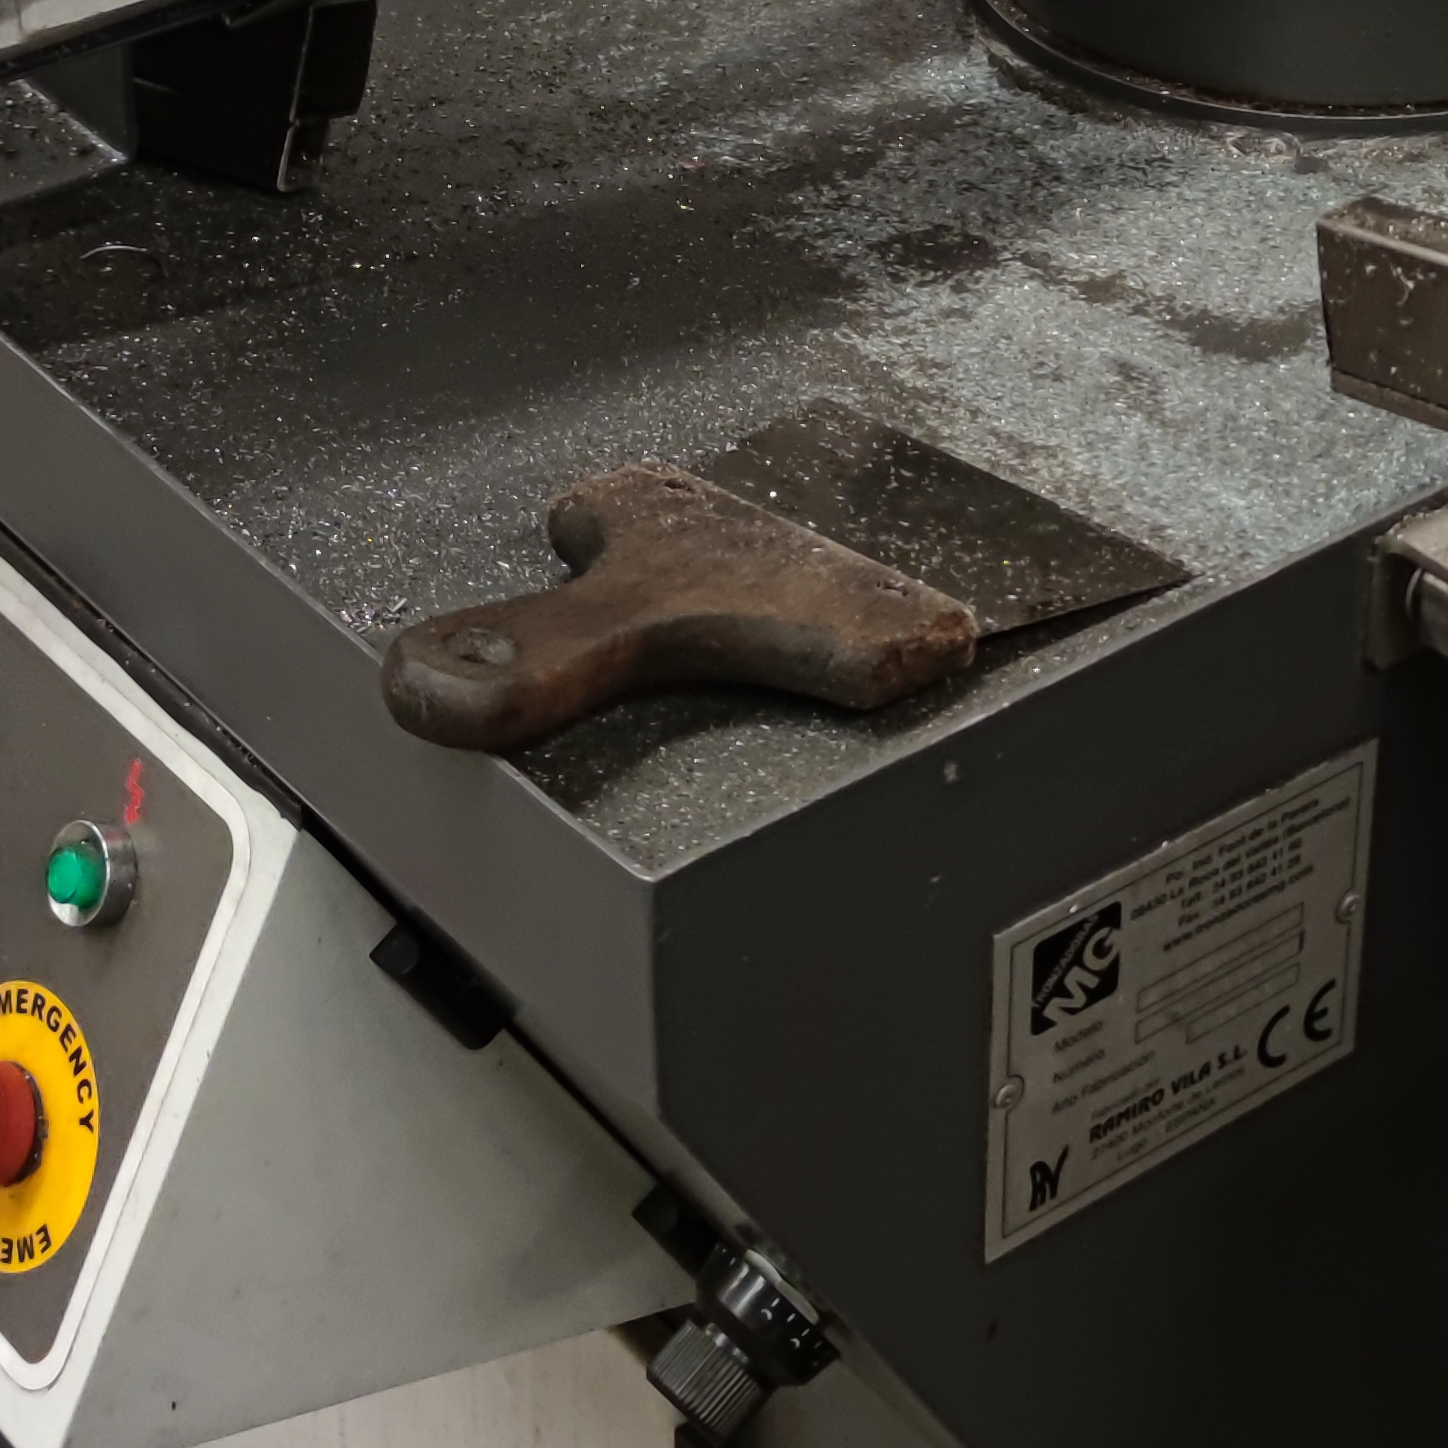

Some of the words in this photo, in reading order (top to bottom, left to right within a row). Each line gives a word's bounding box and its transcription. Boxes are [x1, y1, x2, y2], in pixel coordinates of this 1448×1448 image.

[1043, 926, 1120, 1022] MG
[1089, 1088, 1164, 1142] RAMIRO
[1170, 1061, 1210, 1094] VILA
[1217, 1045, 1246, 1069] S.L.
